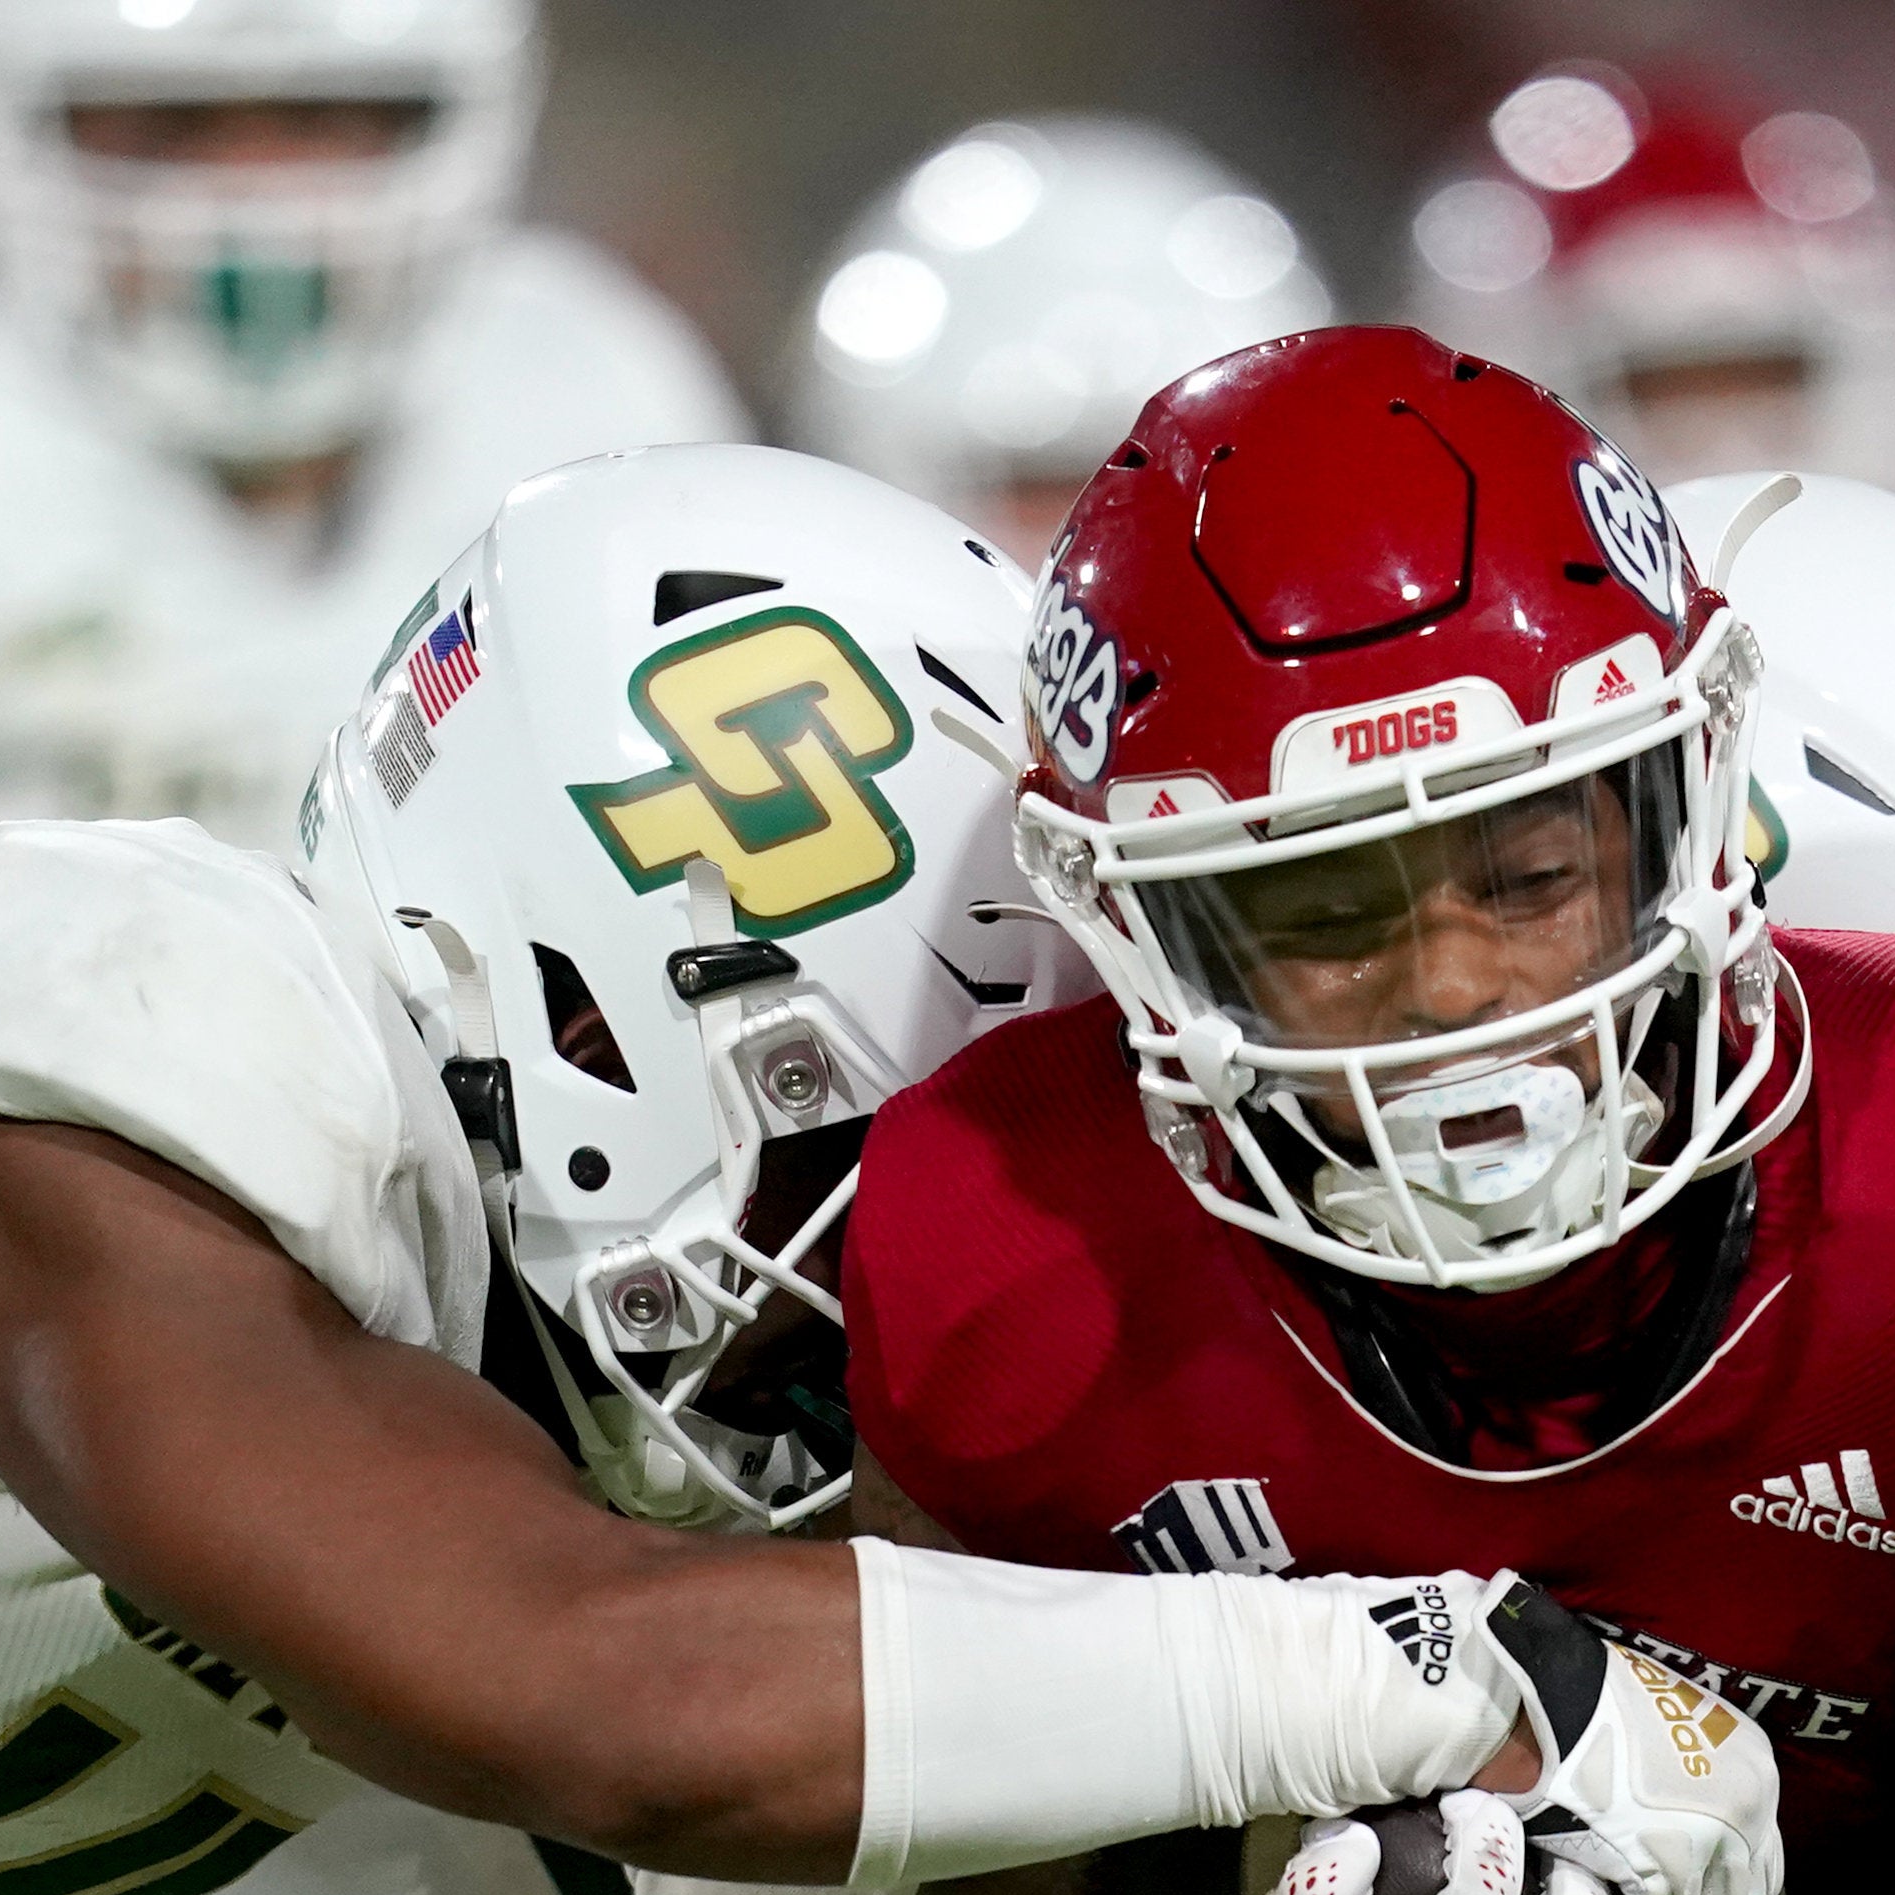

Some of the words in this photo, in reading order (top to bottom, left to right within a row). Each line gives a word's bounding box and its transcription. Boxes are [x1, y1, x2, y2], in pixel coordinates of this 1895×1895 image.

[1333, 700, 1458, 765] 'DOGS
[1416, 1584, 1455, 1686] adidas
[1577, 1611, 1870, 1741] TATE
